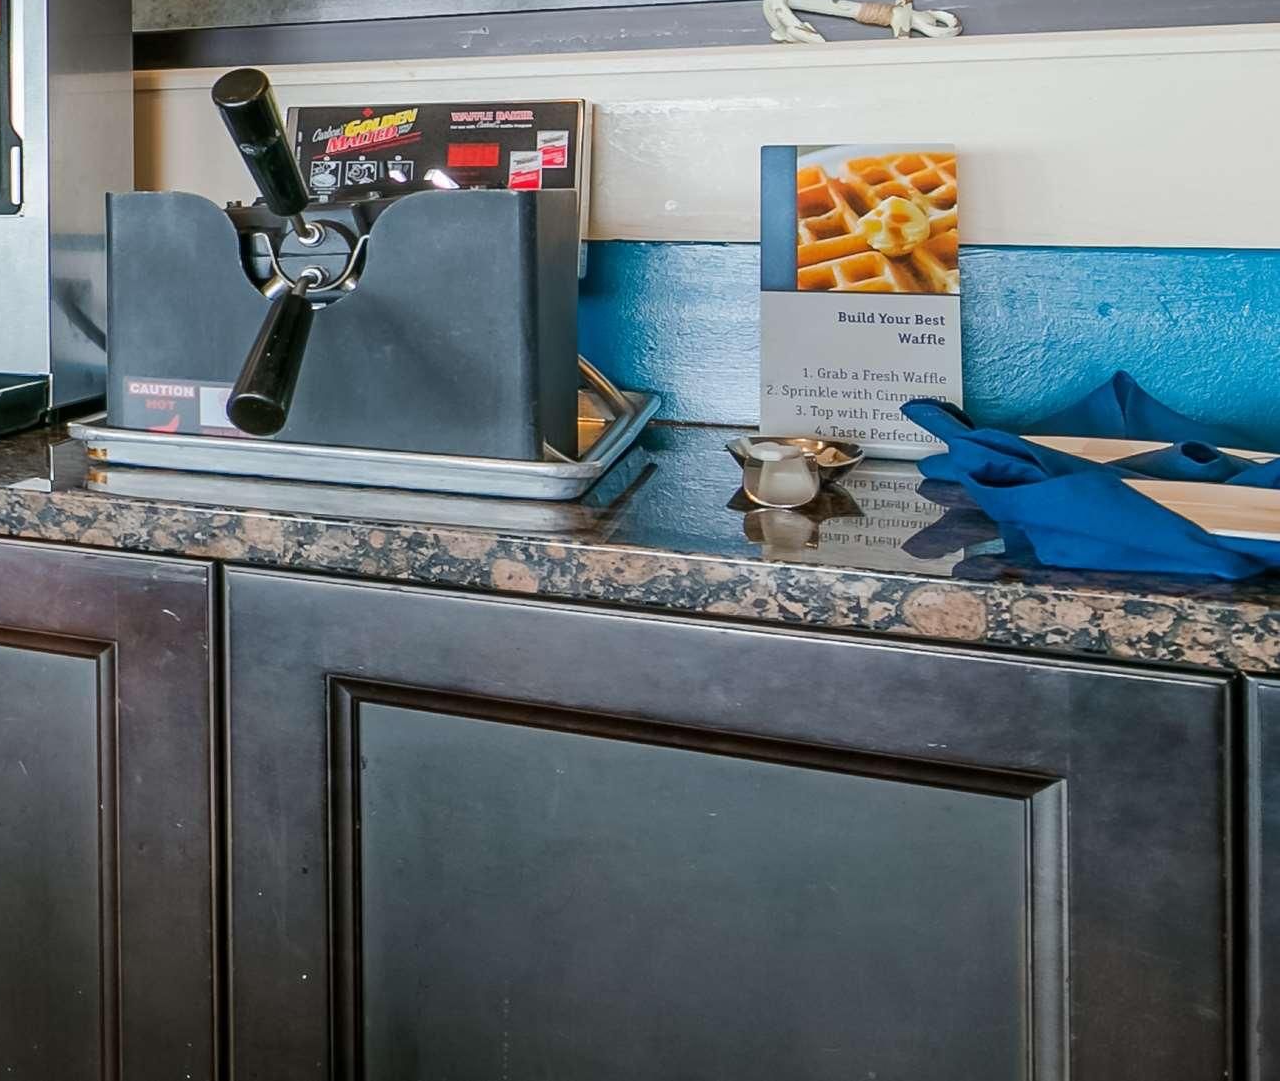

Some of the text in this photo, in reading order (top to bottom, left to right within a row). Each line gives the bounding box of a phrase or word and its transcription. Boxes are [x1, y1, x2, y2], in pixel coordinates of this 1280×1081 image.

[345, 108, 418, 137] GOLDEN
[450, 110, 534, 122] WAFFLE BAKER
[326, 125, 398, 153] MALTED
[838, 311, 945, 326] Build Your Best
[898, 333, 945, 346] Waffle
[802, 368, 947, 384] 1. Grab a Fresh Waffle
[129, 383, 195, 397] CAUTION
[766, 385, 778, 396] 2.
[782, 385, 838, 399] Sprinkle
[842, 388, 872, 400] with
[145, 400, 176, 409] HOT
[795, 406, 806, 416] 3.
[810, 406, 833, 419] Top
[837, 407, 868, 419] with
[814, 426, 826, 436] 4.
[830, 426, 866, 439] Taste
